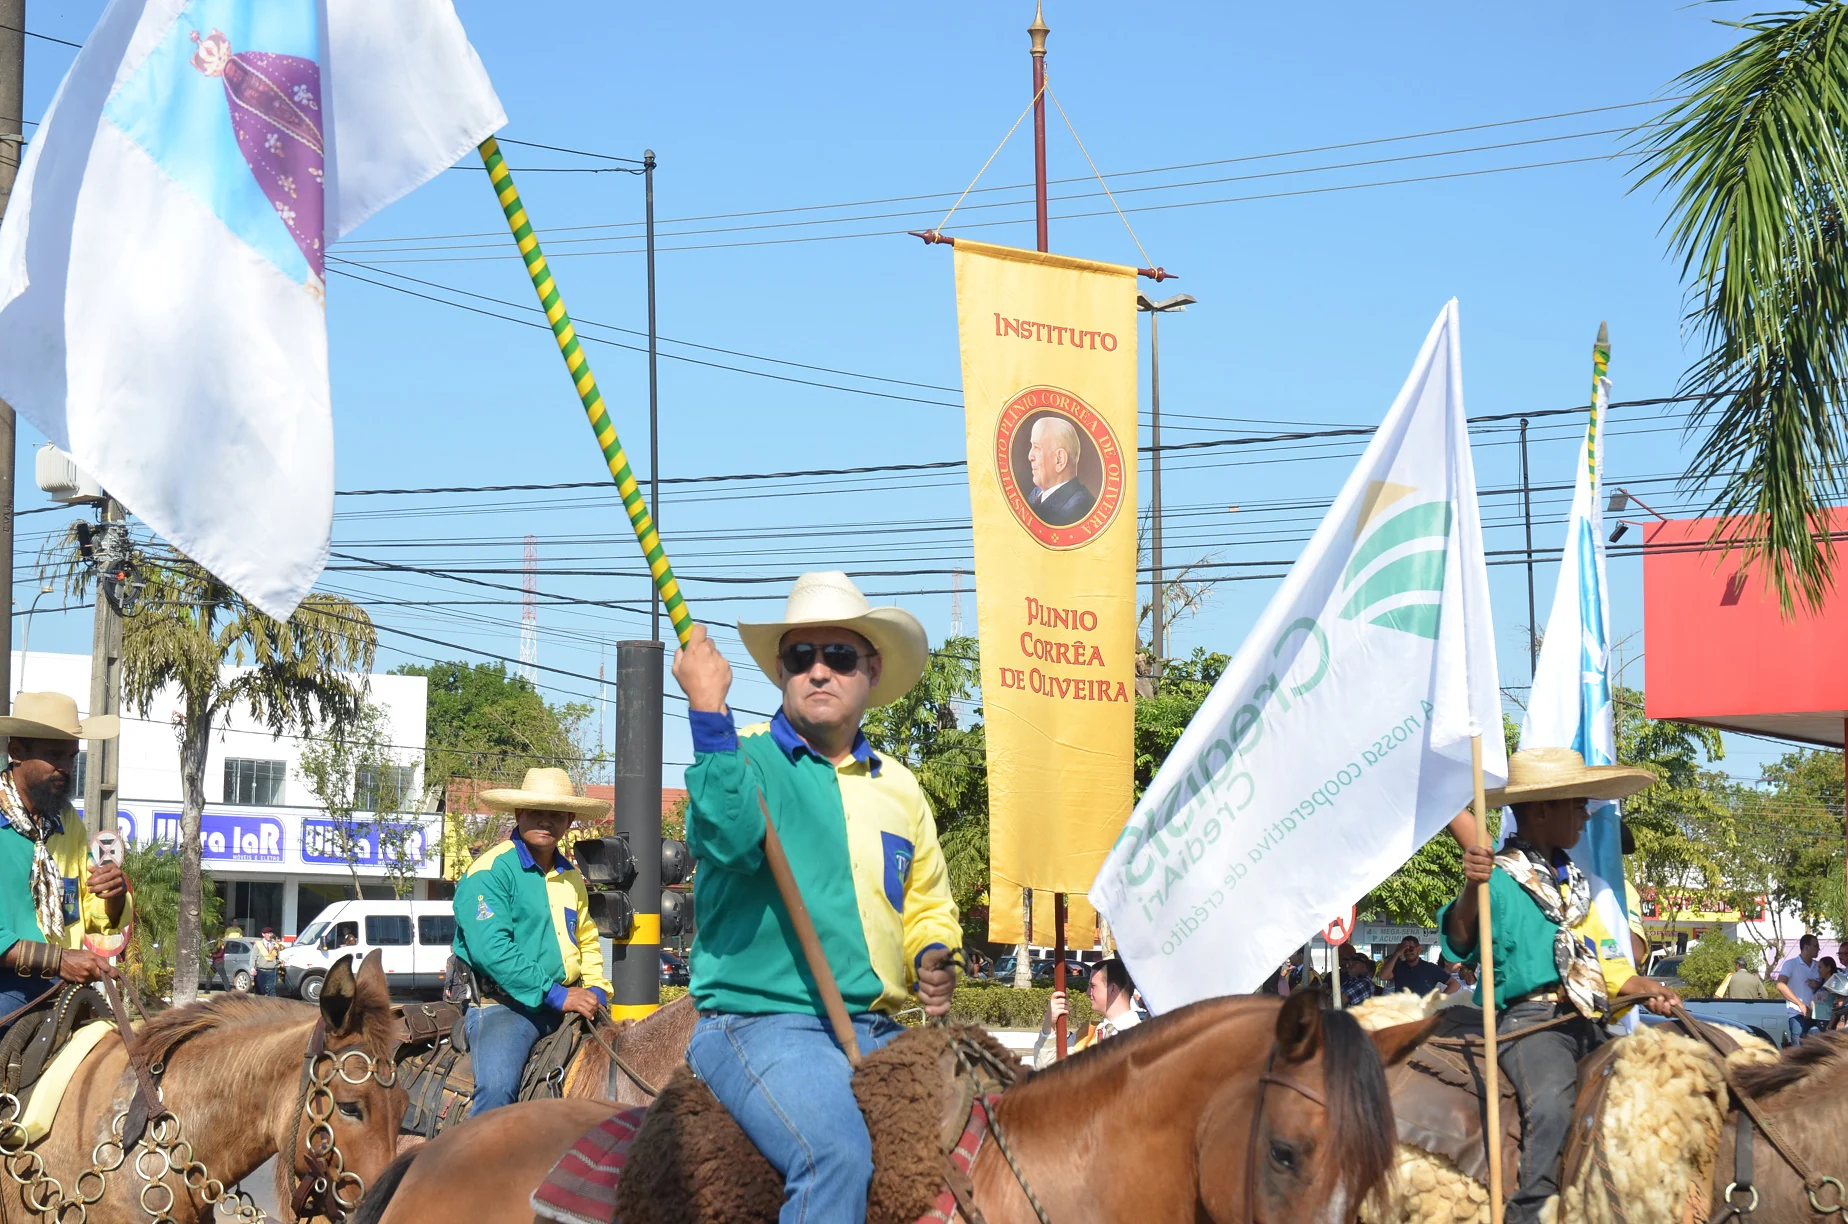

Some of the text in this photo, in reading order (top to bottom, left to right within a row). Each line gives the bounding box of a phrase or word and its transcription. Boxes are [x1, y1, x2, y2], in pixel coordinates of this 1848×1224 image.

[993, 312, 1118, 352] INSTITUTO
[997, 391, 1120, 535] INSTITUTO PLINIO CORRÊA DE OLIVEIRA
[1024, 596, 1098, 631] PLINIO
[1020, 631, 1106, 667] CORRÊA
[1029, 667, 1129, 702] OLIVEIRA
